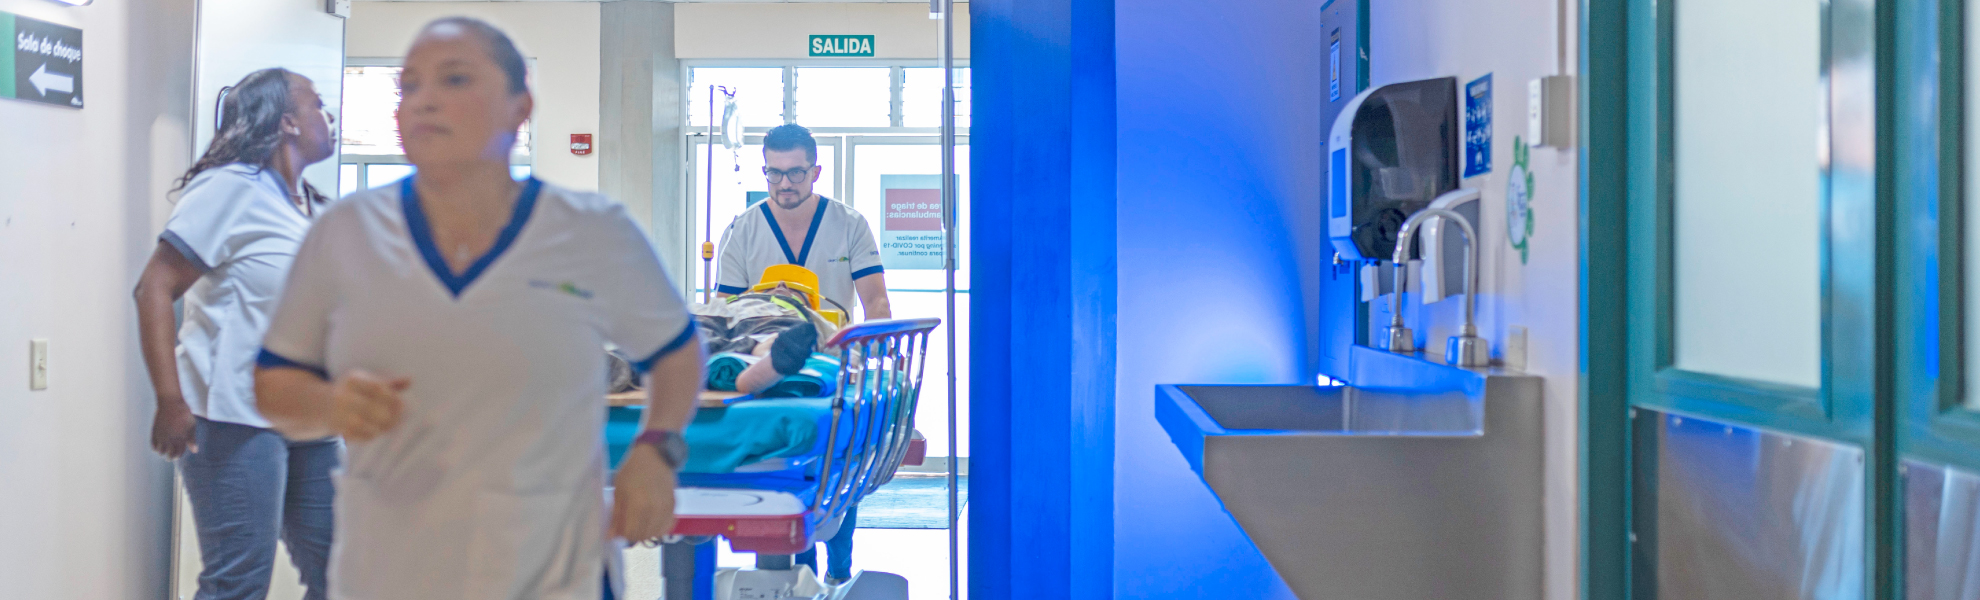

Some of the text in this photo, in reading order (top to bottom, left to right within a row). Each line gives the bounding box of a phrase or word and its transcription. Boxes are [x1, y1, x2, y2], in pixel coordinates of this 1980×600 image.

[17, 30, 81, 64] Sala de choque
[812, 37, 872, 54] SALIDA
